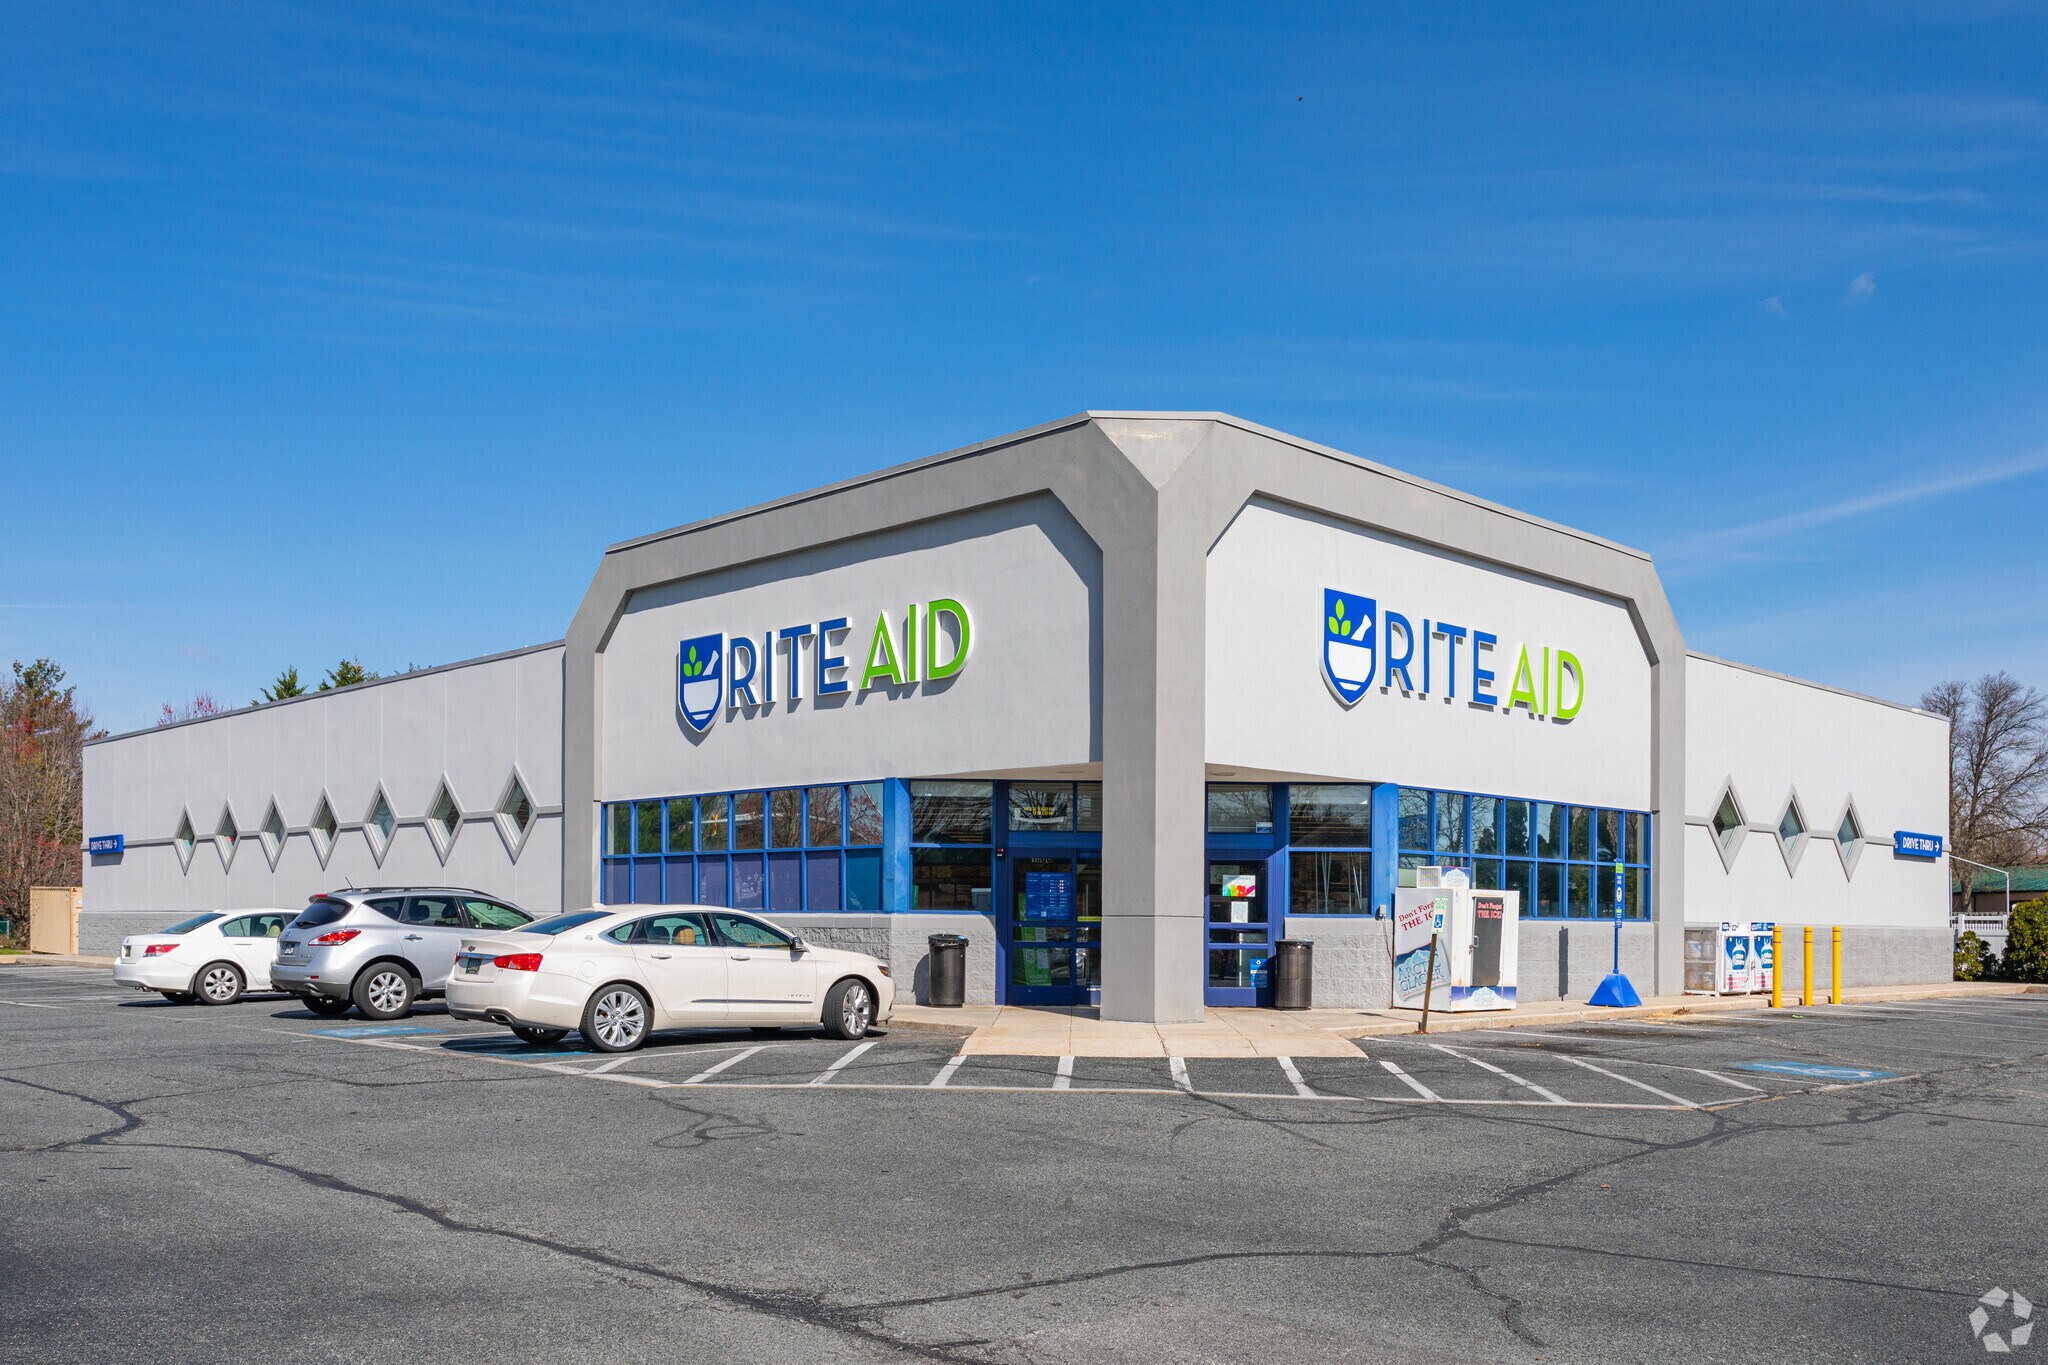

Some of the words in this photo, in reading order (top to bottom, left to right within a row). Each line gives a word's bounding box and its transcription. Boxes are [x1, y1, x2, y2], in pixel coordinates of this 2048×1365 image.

[729, 616, 853, 709] RITE
[860, 598, 975, 690] AID
[1381, 609, 1498, 707] RITE
[1503, 640, 1585, 721] AID
[90, 841, 102, 850] DRIVE
[1902, 836, 1919, 850] DRIVE
[1919, 838, 1934, 851] THRU
[1398, 908, 1418, 922] Don't
[1417, 900, 1435, 913] Forg
[1401, 916, 1423, 931] THE
[1424, 909, 1434, 921] IC
[1477, 910, 1490, 918] THE
[1398, 953, 1441, 981] ARCTC
[1400, 966, 1445, 992] GLACR
